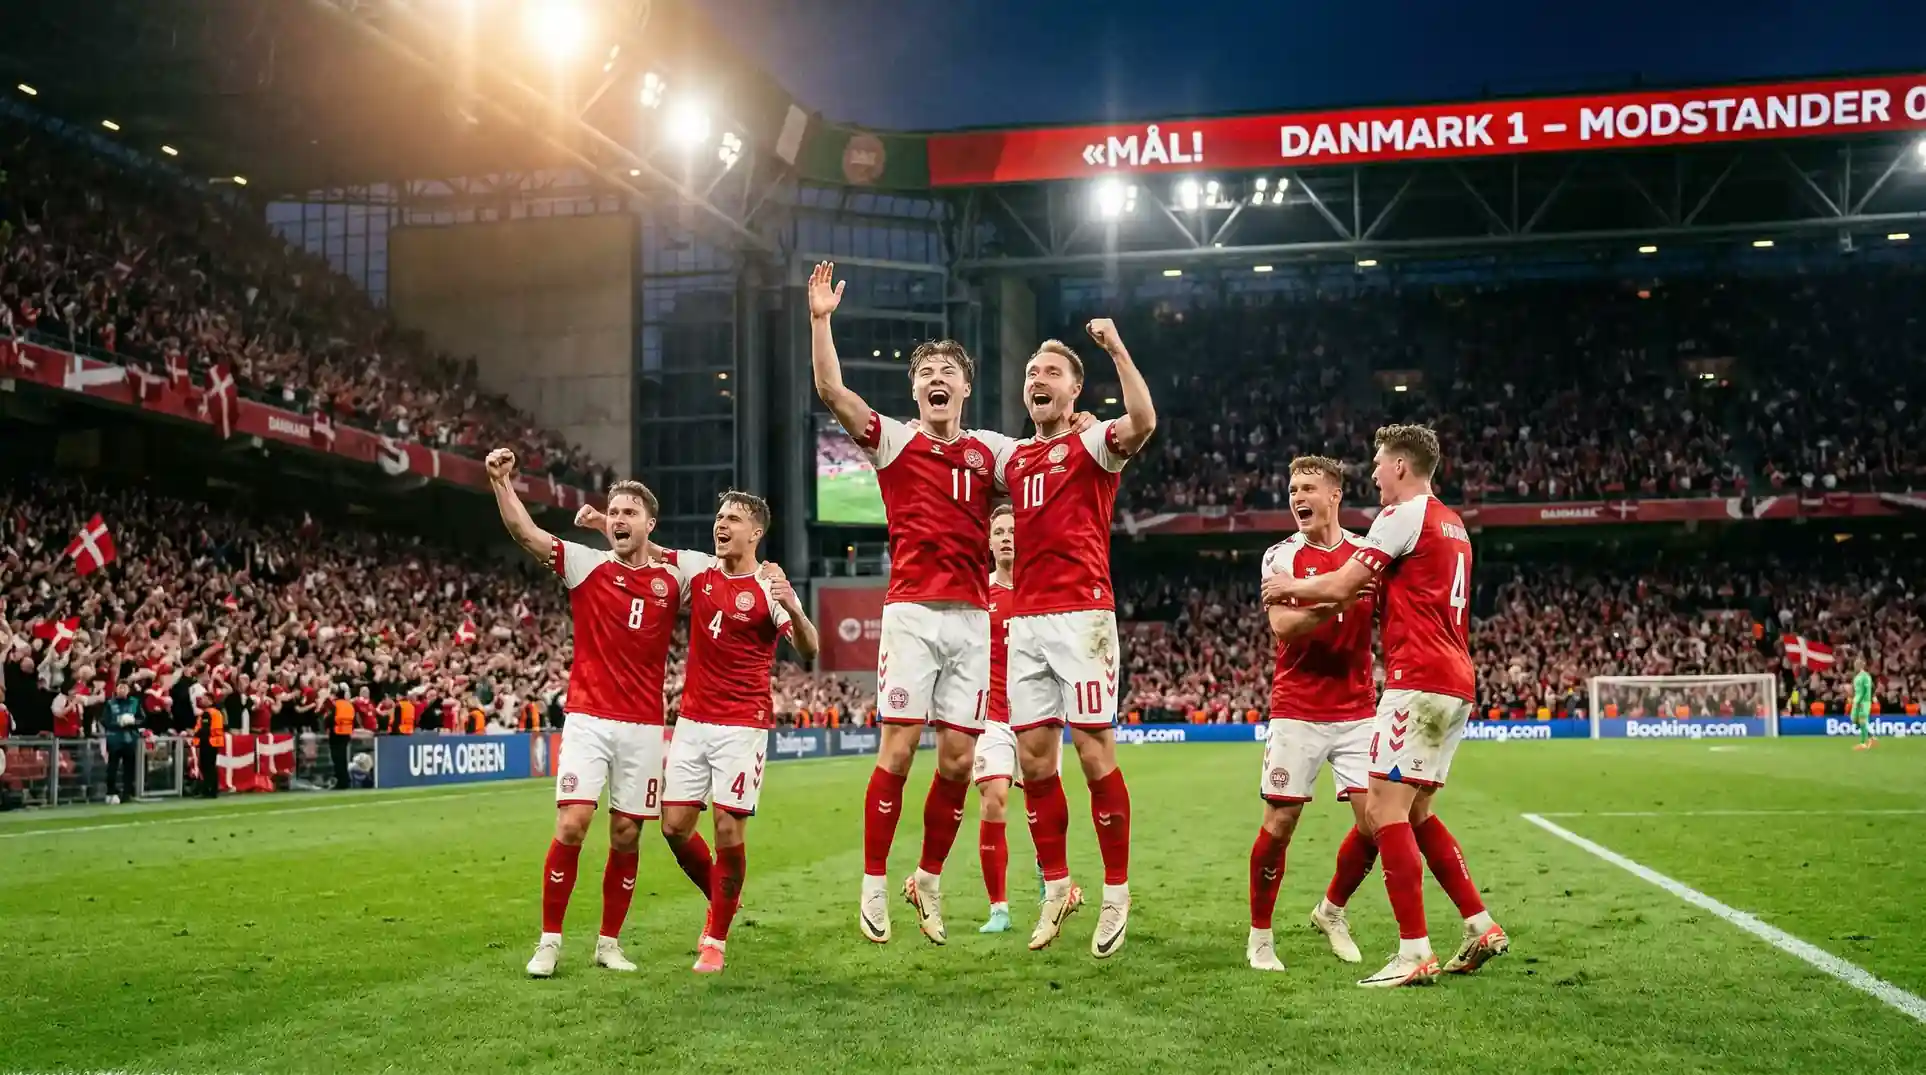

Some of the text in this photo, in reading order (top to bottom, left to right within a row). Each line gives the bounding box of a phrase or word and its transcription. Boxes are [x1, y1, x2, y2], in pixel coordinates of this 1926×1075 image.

[1281, 115, 1494, 158] DANMARK
[1507, 111, 1529, 144] 1
[1580, 90, 1891, 141] MODSTANDER
[951, 468, 971, 502] 11
[1023, 472, 1045, 510] 10
[1450, 552, 1466, 626] 4
[628, 598, 644, 629] 8
[708, 610, 722, 639] 4
[1074, 680, 1102, 714] 10
[1115, 725, 1186, 745] ing.com
[1626, 720, 1747, 739] Booking.com
[409, 743, 454, 777] UEFA
[1369, 731, 1380, 764] 4
[645, 778, 658, 809] 8
[731, 771, 746, 800] 4
